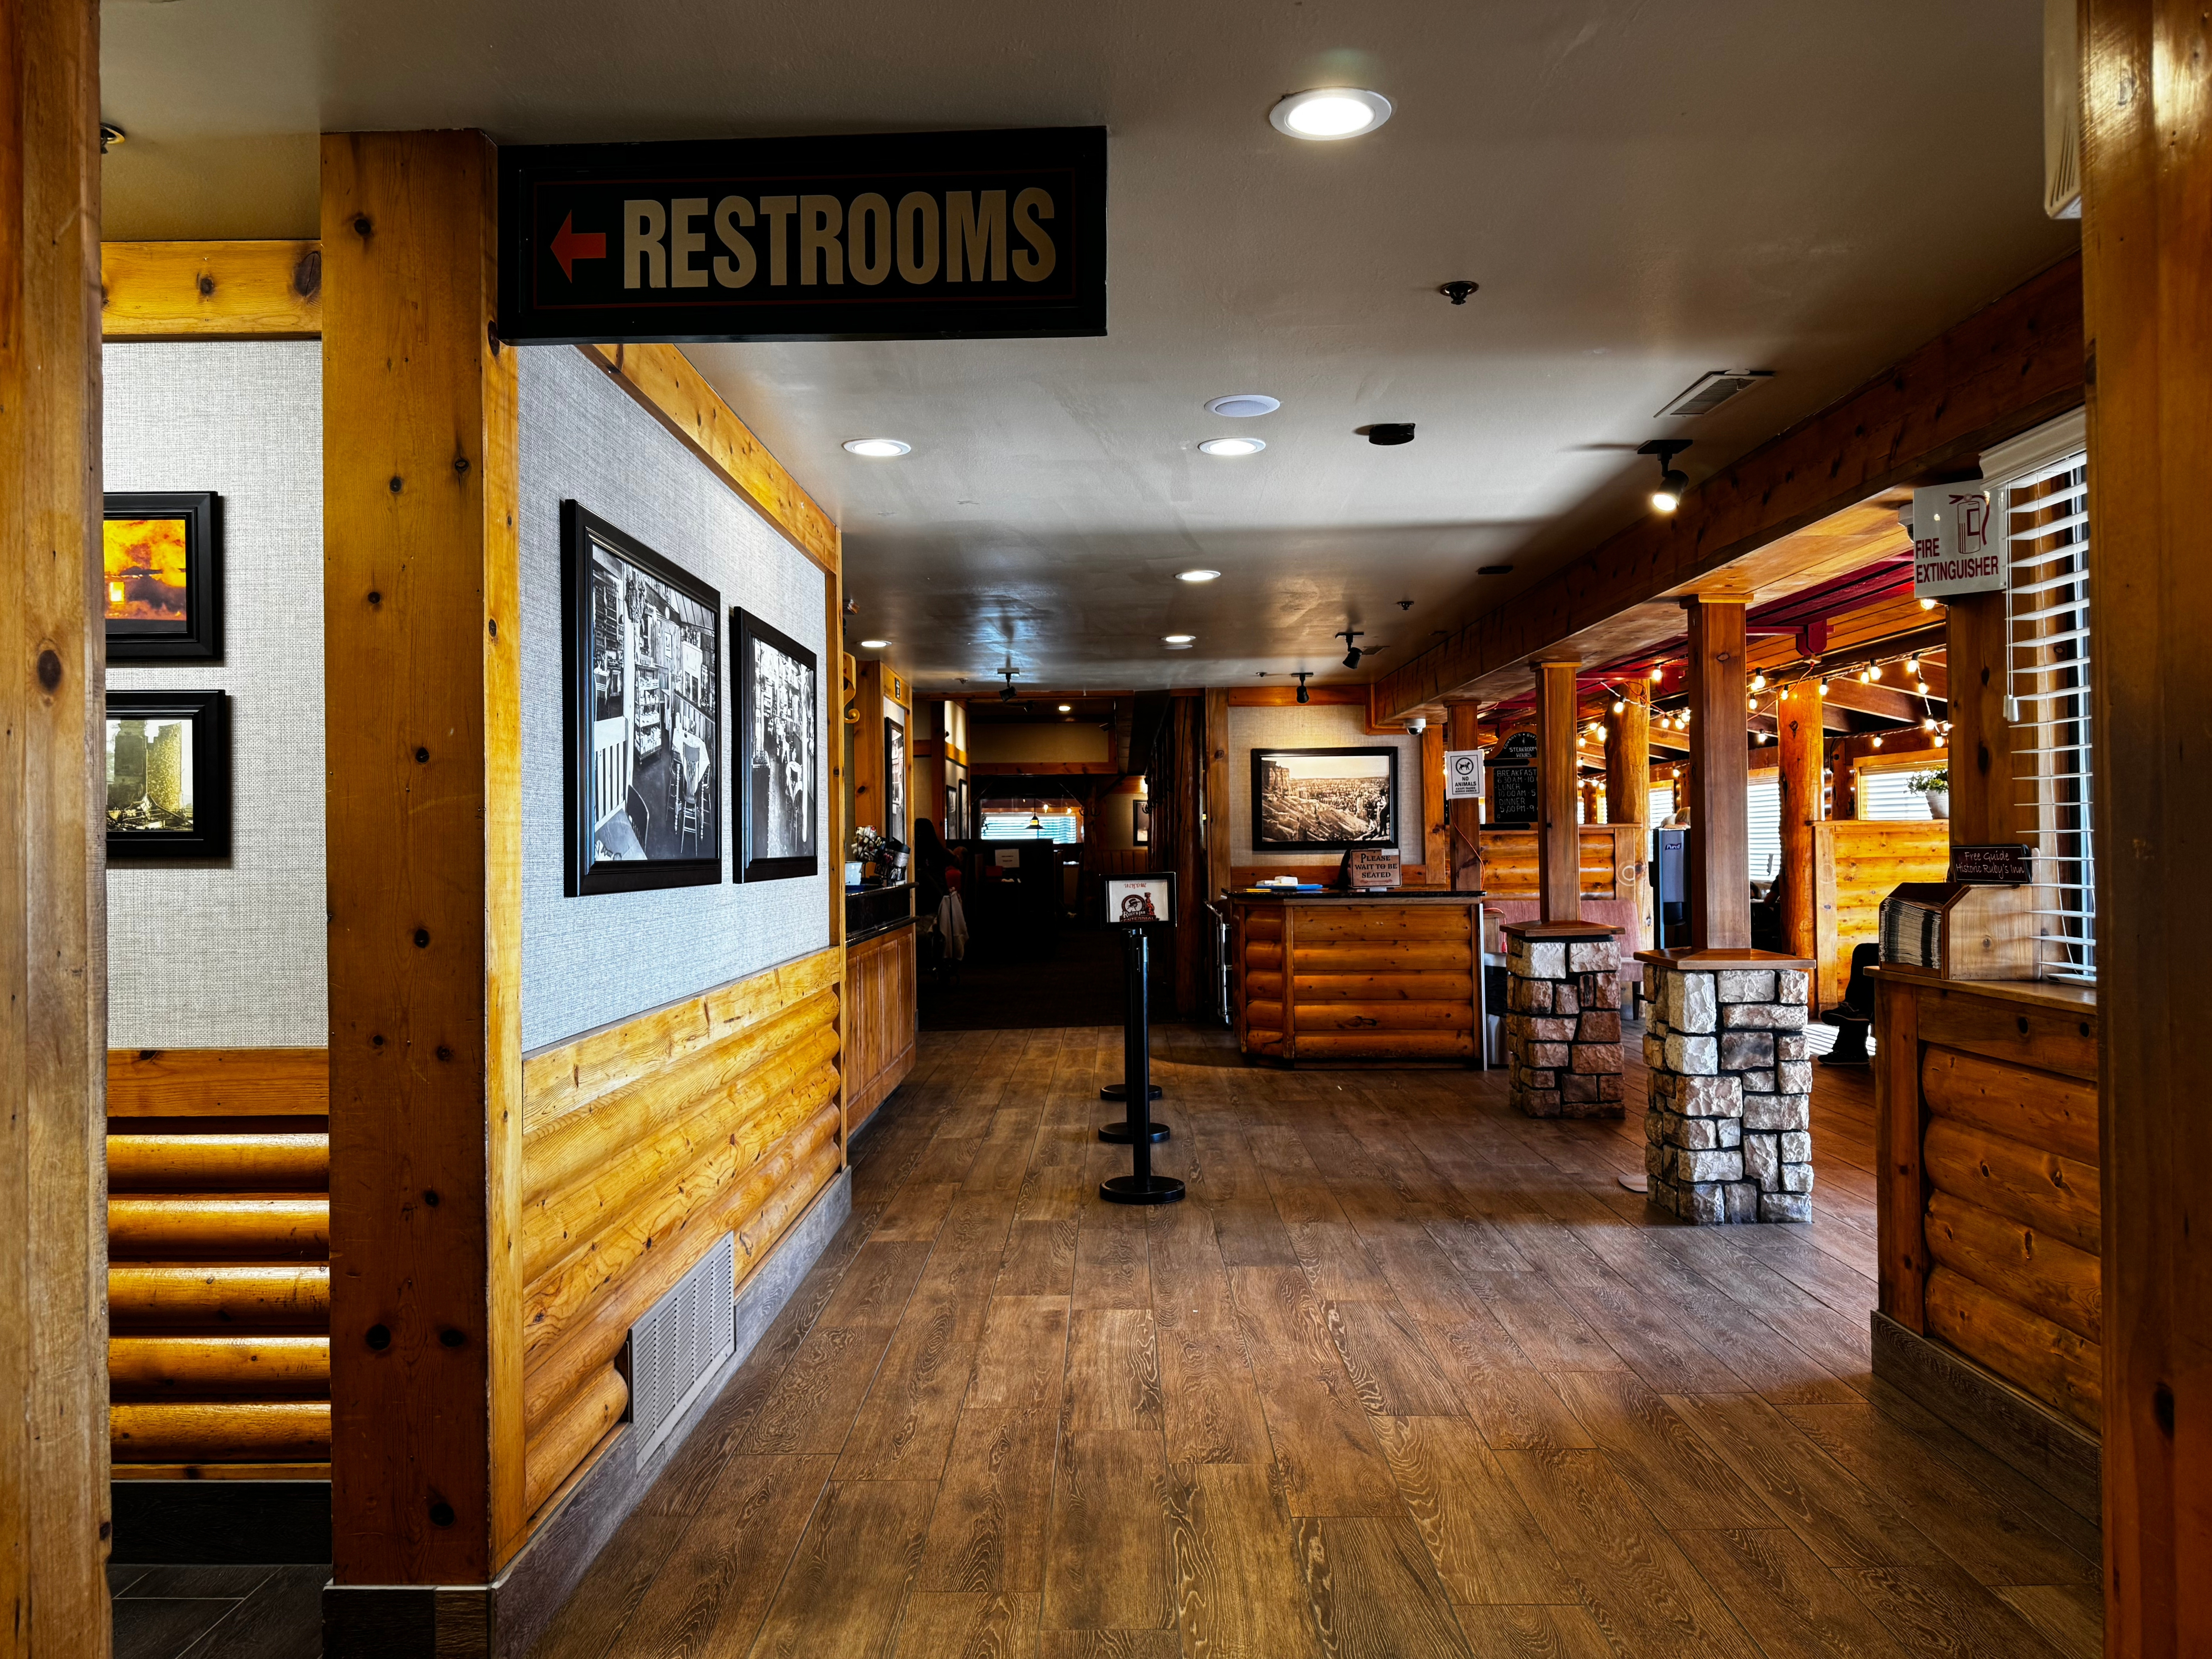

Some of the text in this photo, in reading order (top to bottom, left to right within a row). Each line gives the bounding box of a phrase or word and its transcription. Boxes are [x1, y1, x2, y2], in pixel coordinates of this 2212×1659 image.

[624, 187, 1056, 289] RESTROOMS
[1916, 538, 1940, 559] FIRE
[1917, 556, 1998, 583] EXTINGUISHER
[1361, 854, 1390, 863] PLEASE
[1965, 850, 2009, 862] Free Guide
[1956, 862, 2024, 879] Historic Ruby's Inn
